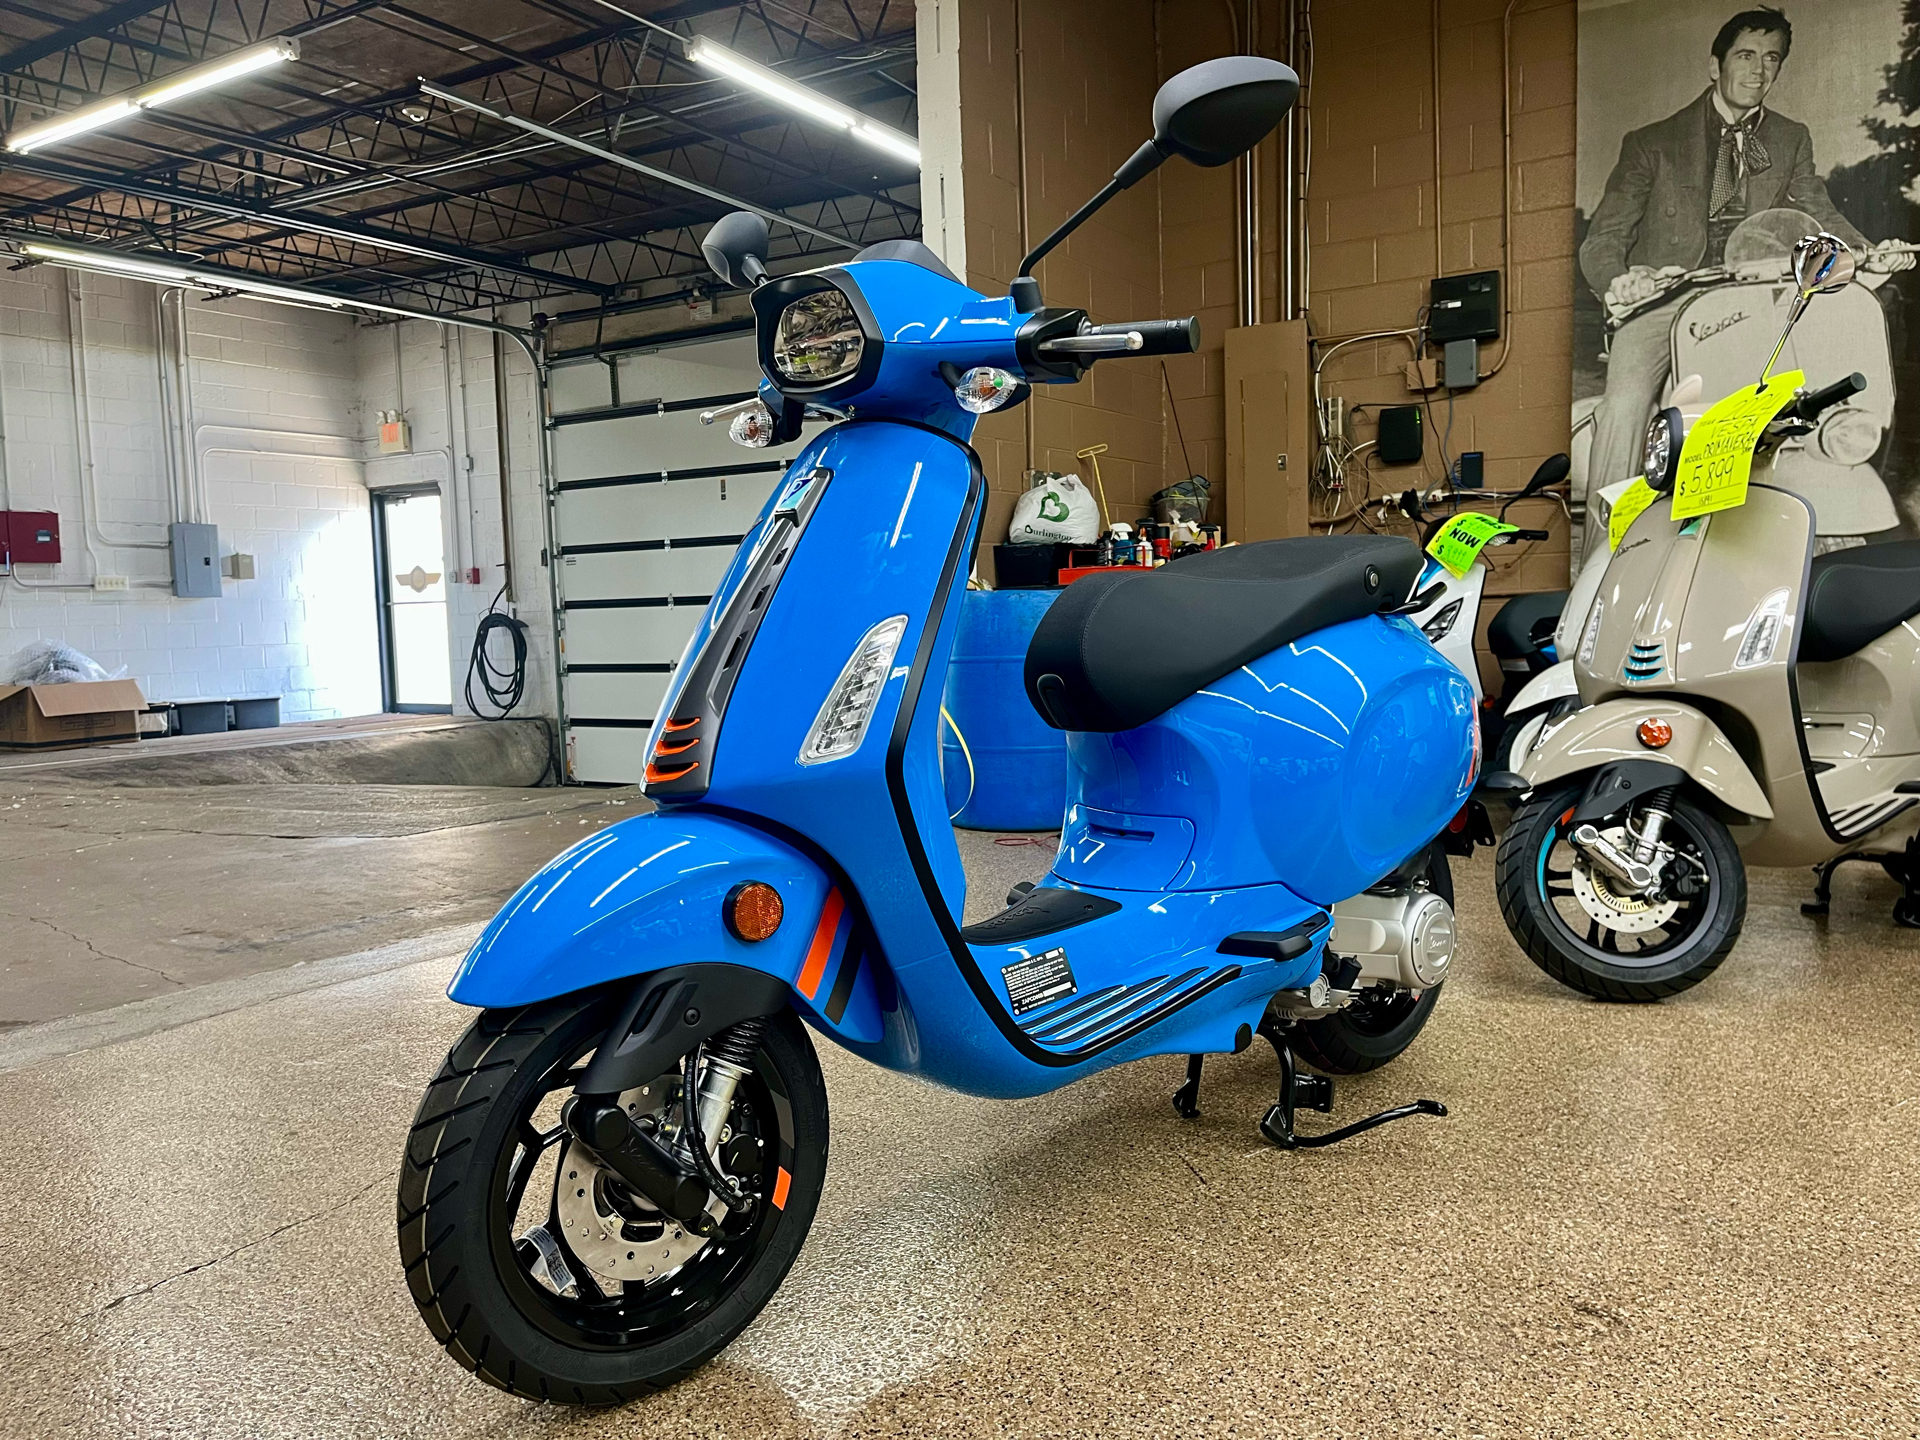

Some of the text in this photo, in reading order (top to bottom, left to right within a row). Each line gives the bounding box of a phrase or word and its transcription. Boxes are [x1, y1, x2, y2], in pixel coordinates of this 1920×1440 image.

[1711, 416, 1759, 439] VESPA
[1024, 524, 1072, 541] Burlington
[1449, 527, 1481, 549] NOW
